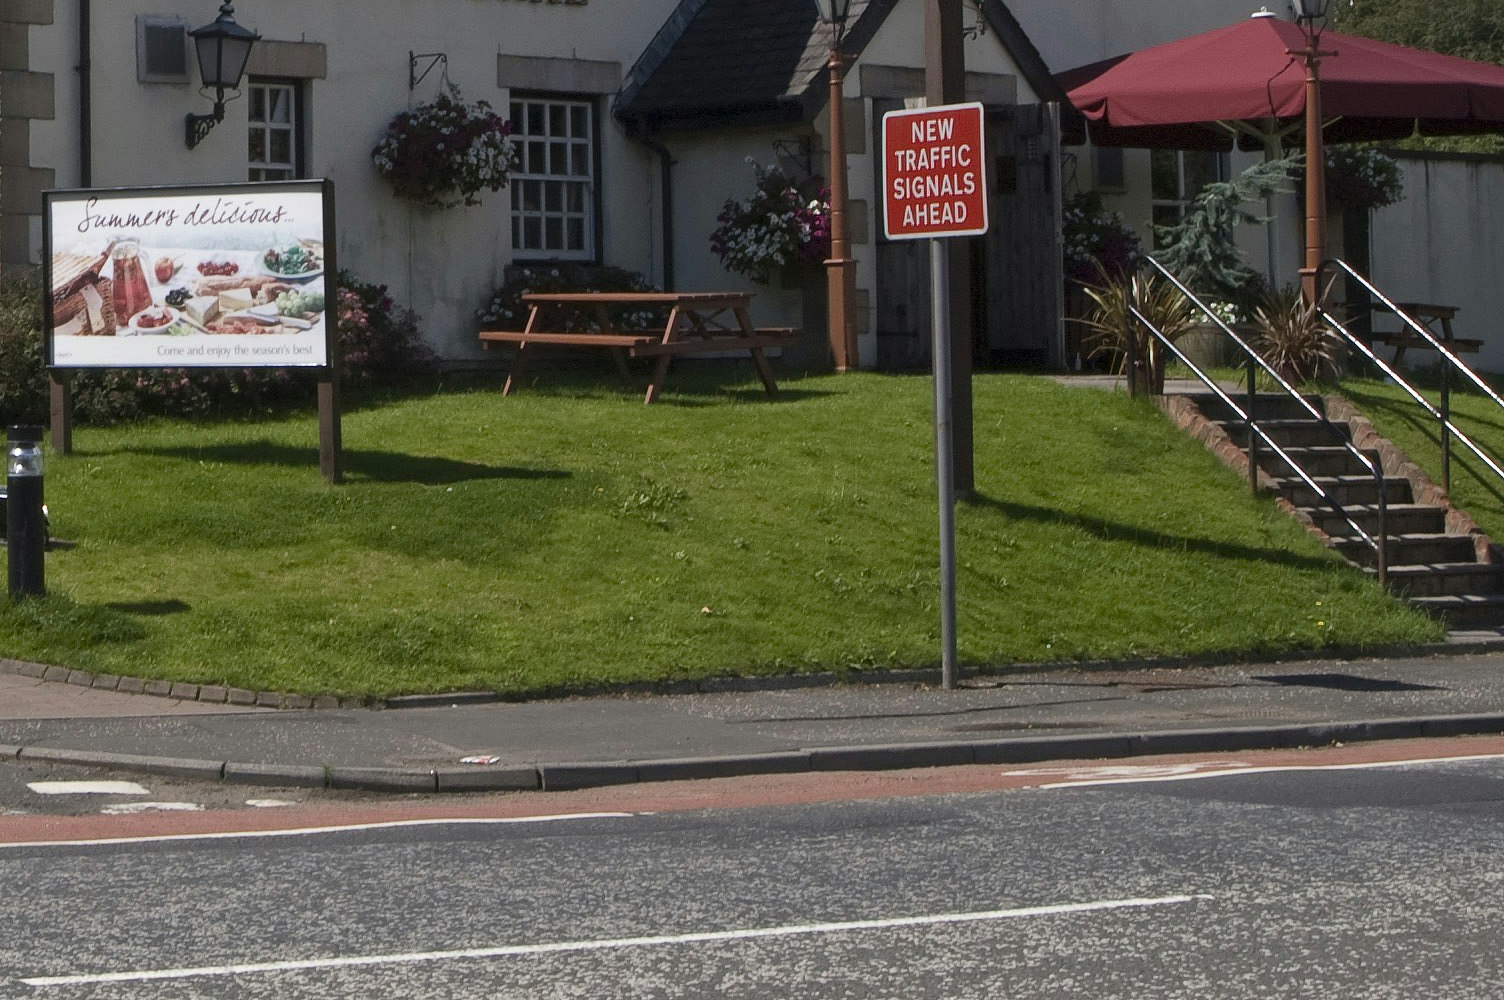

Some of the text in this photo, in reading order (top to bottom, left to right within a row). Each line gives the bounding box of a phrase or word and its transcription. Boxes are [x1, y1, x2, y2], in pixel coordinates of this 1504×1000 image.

[911, 117, 954, 143] NEW
[894, 144, 971, 172] TRAFFIC
[893, 172, 976, 200] SIGNALS
[77, 196, 180, 232] Summer's
[902, 200, 968, 227] AHEAD
[157, 344, 313, 359] Come and enjoy the season's best
